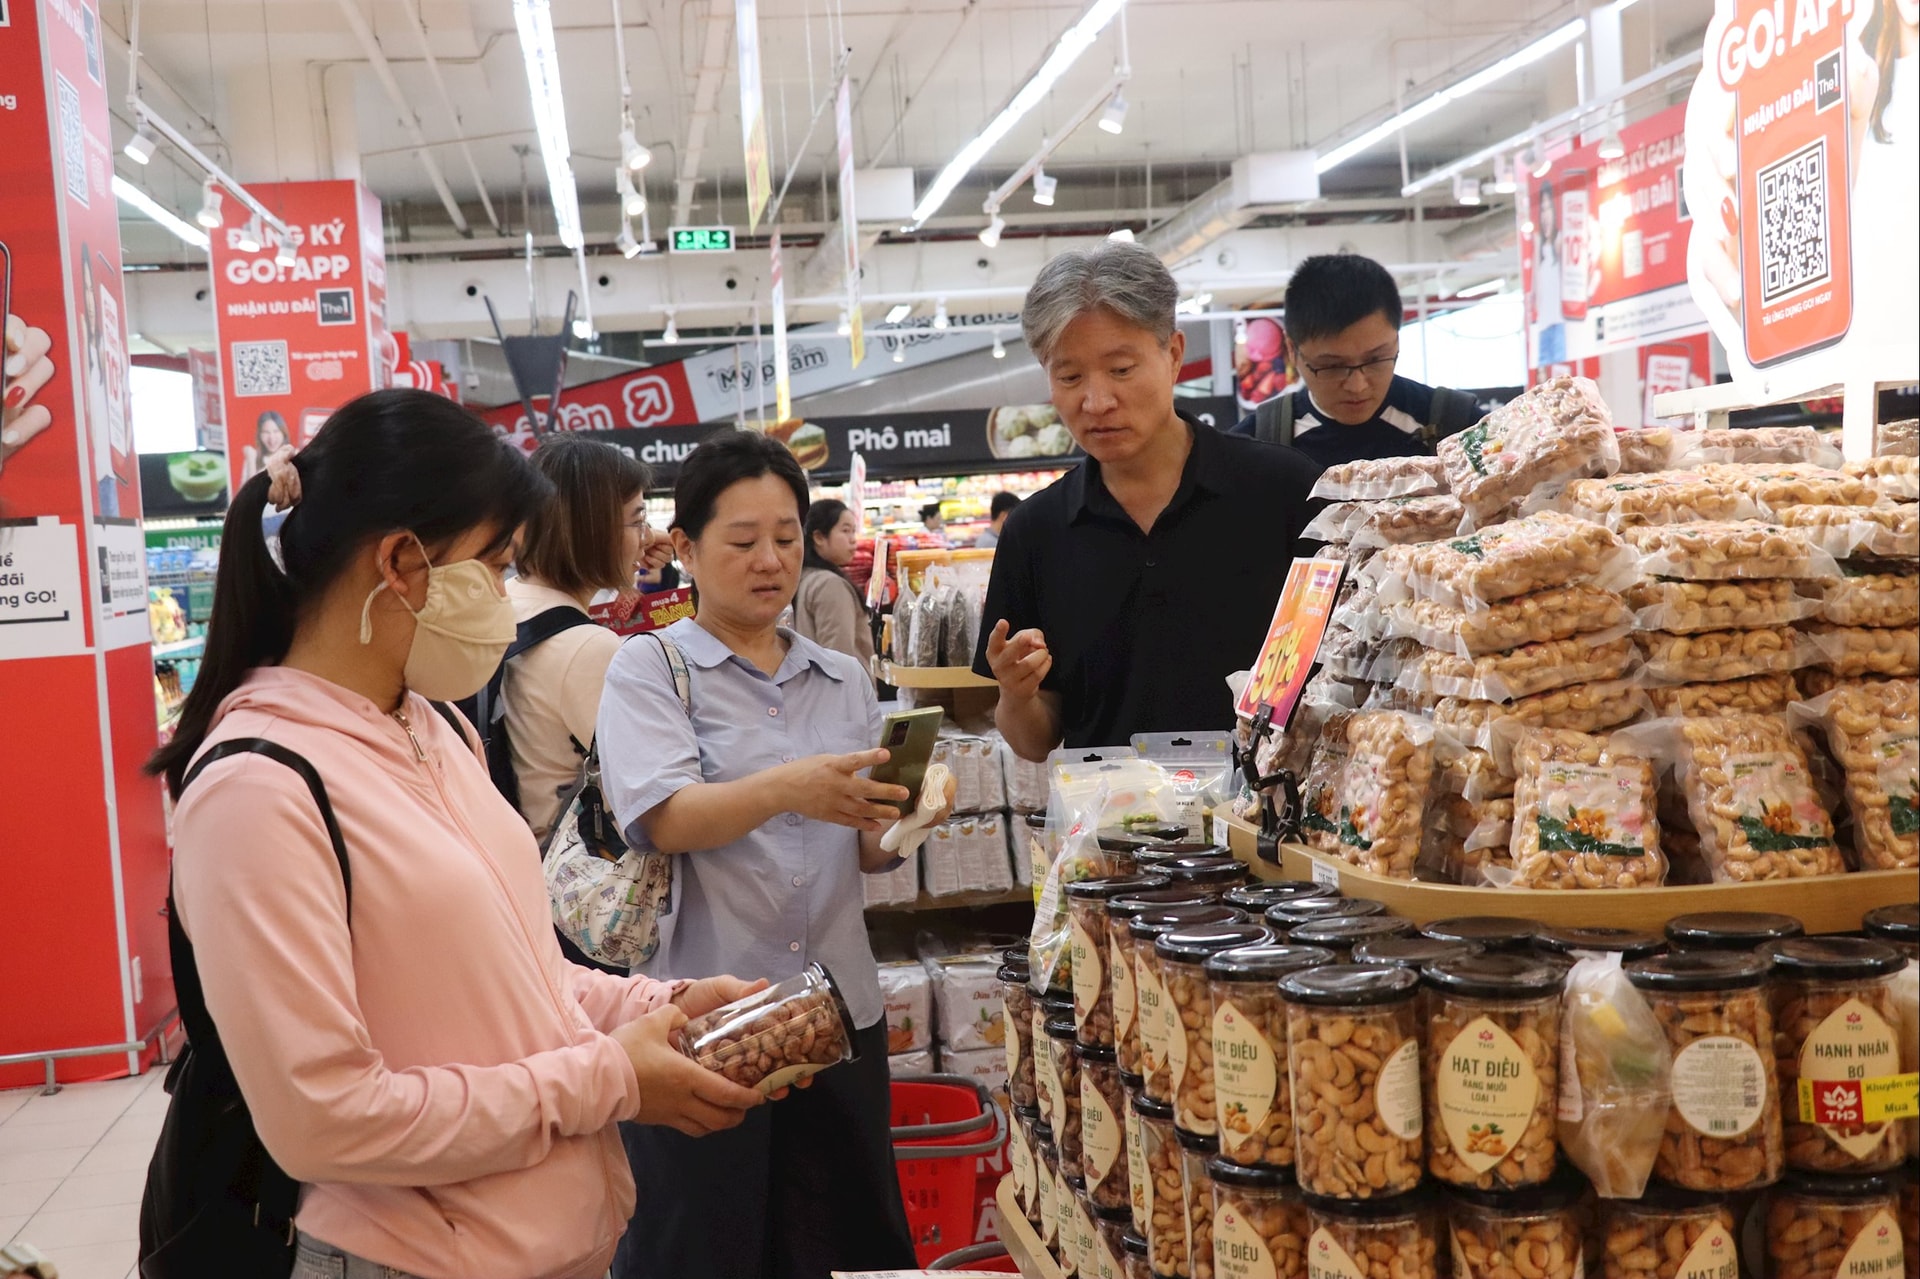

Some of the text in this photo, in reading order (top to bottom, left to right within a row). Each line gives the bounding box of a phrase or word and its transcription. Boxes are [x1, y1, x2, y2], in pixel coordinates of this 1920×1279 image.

[226, 217, 345, 251] ĐNG KÝ
[226, 254, 350, 285] GO! APP
[848, 423, 951, 451] Phô mai
[25, 590, 56, 604] GO!
[670, 592, 680, 603] 4
[602, 607, 610, 618] 4
[1815, 1040, 1890, 1060] HẠNH NHÂN
[1452, 1055, 1520, 1078] HẠT ĐIỀU
[1463, 1079, 1484, 1091] RANG
[1884, 1103, 1909, 1113] Mua
[1850, 1259, 1884, 1276] HẠNH
